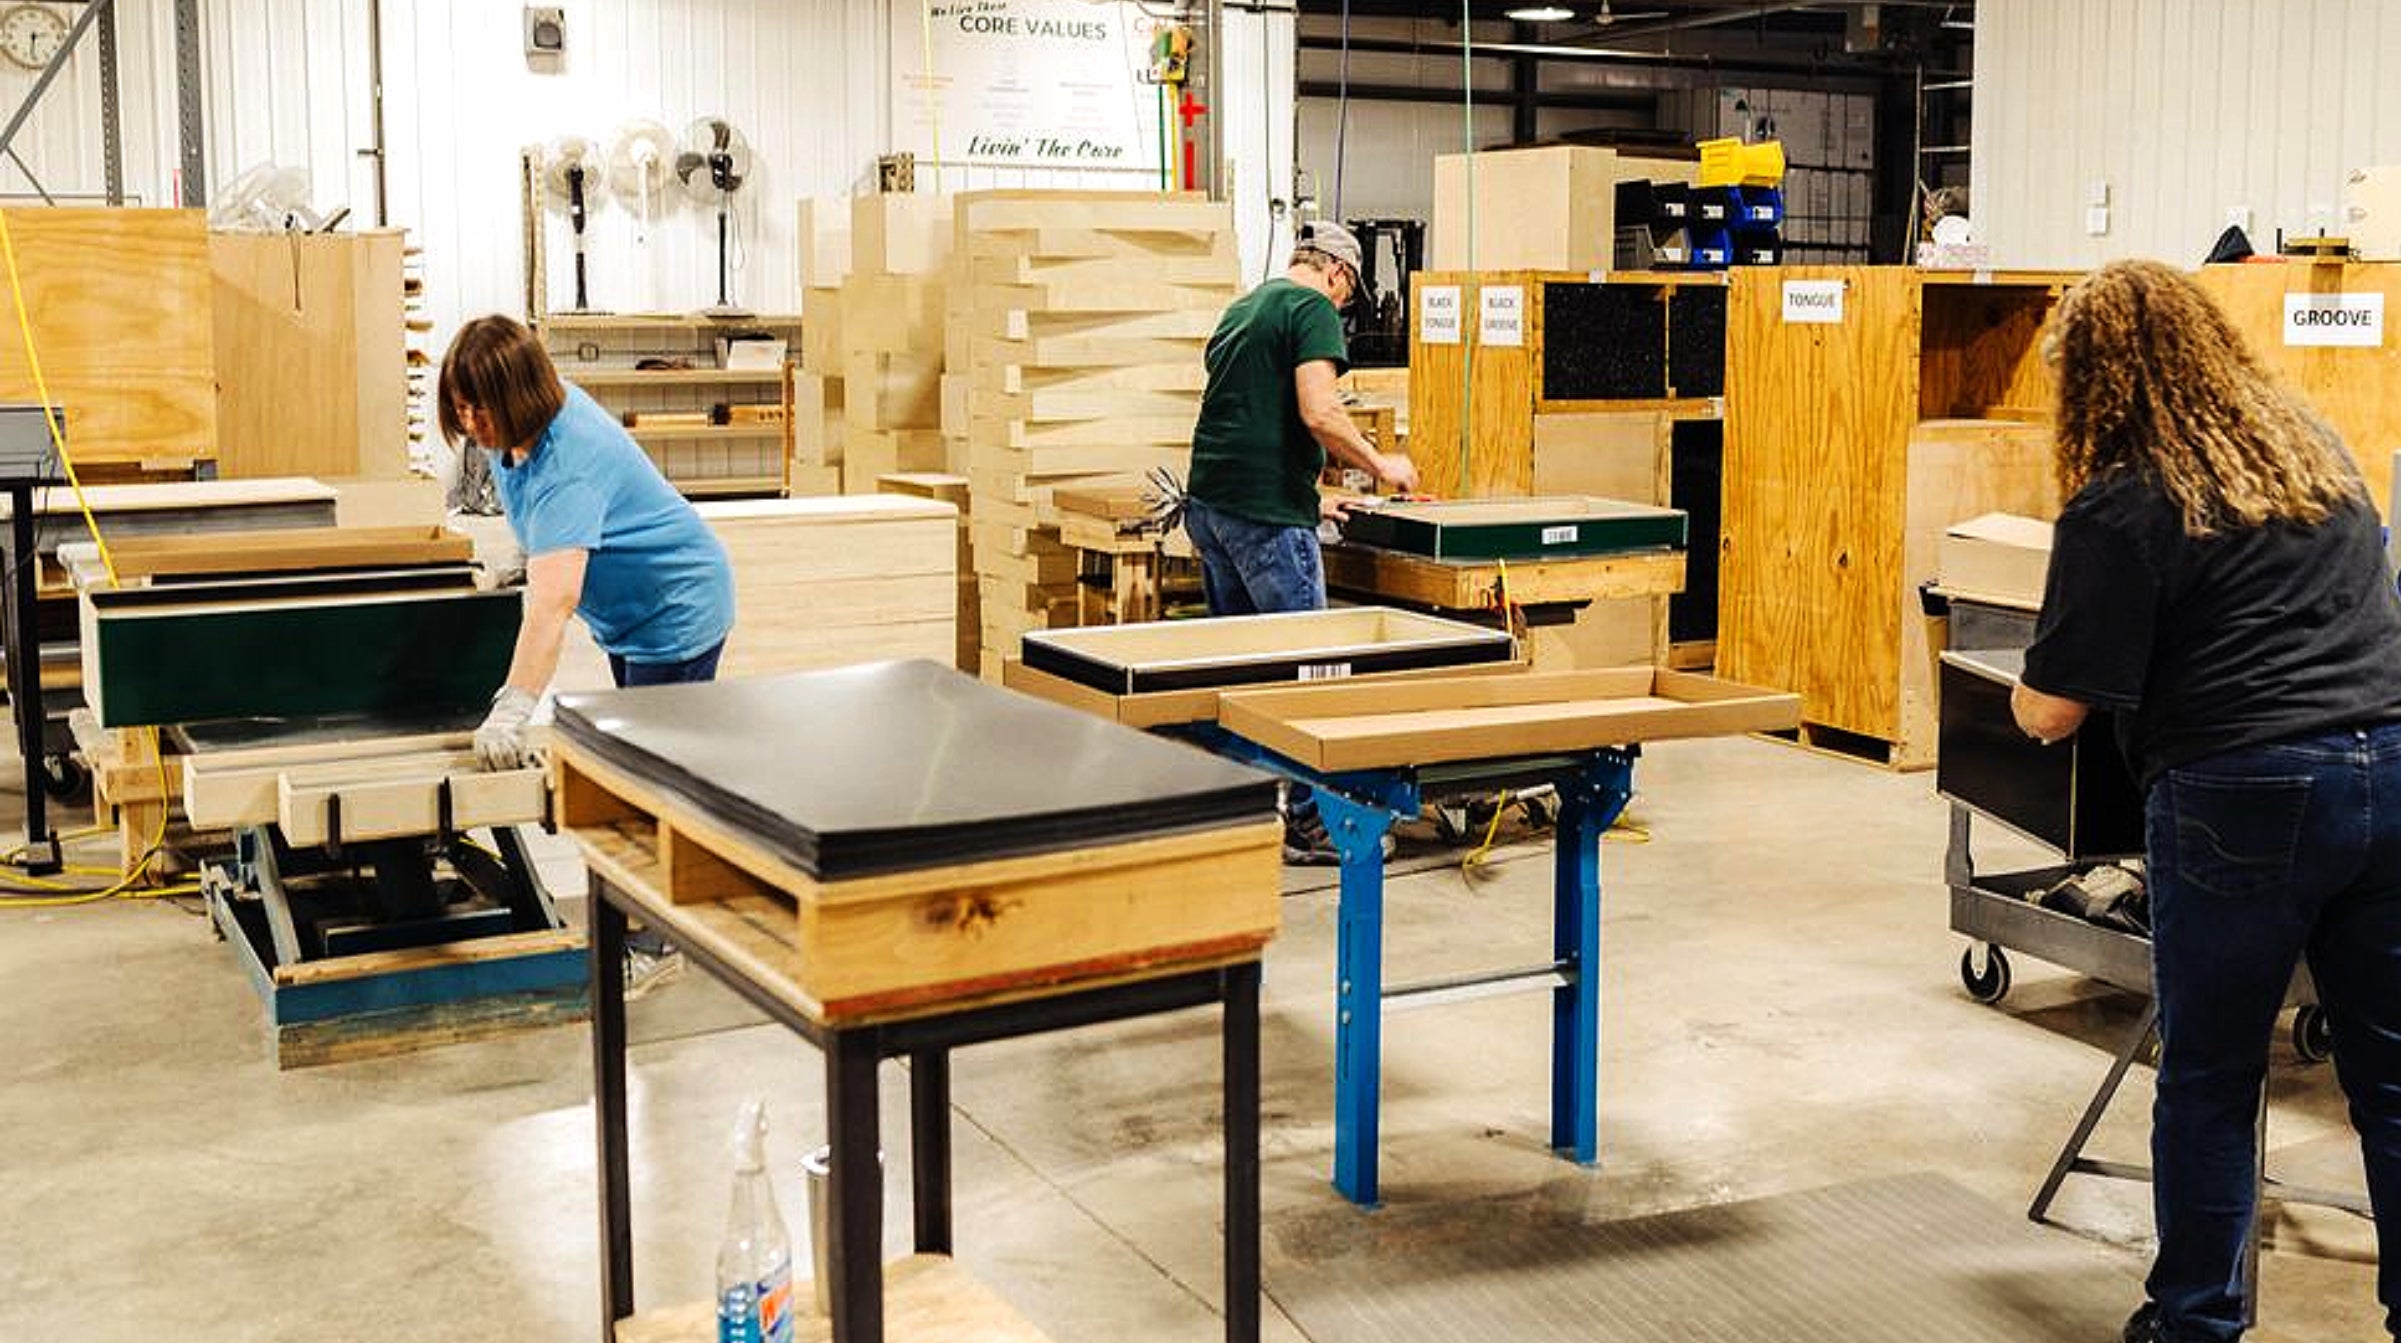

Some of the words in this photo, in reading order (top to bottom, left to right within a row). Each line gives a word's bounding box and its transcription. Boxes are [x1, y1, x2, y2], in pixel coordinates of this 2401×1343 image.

[960, 15, 1018, 34] CORE
[1025, 19, 1106, 39] VALUES
[968, 136, 1029, 157] Livin'
[1035, 138, 1071, 157] The
[2293, 309, 2373, 326] GROOVE
